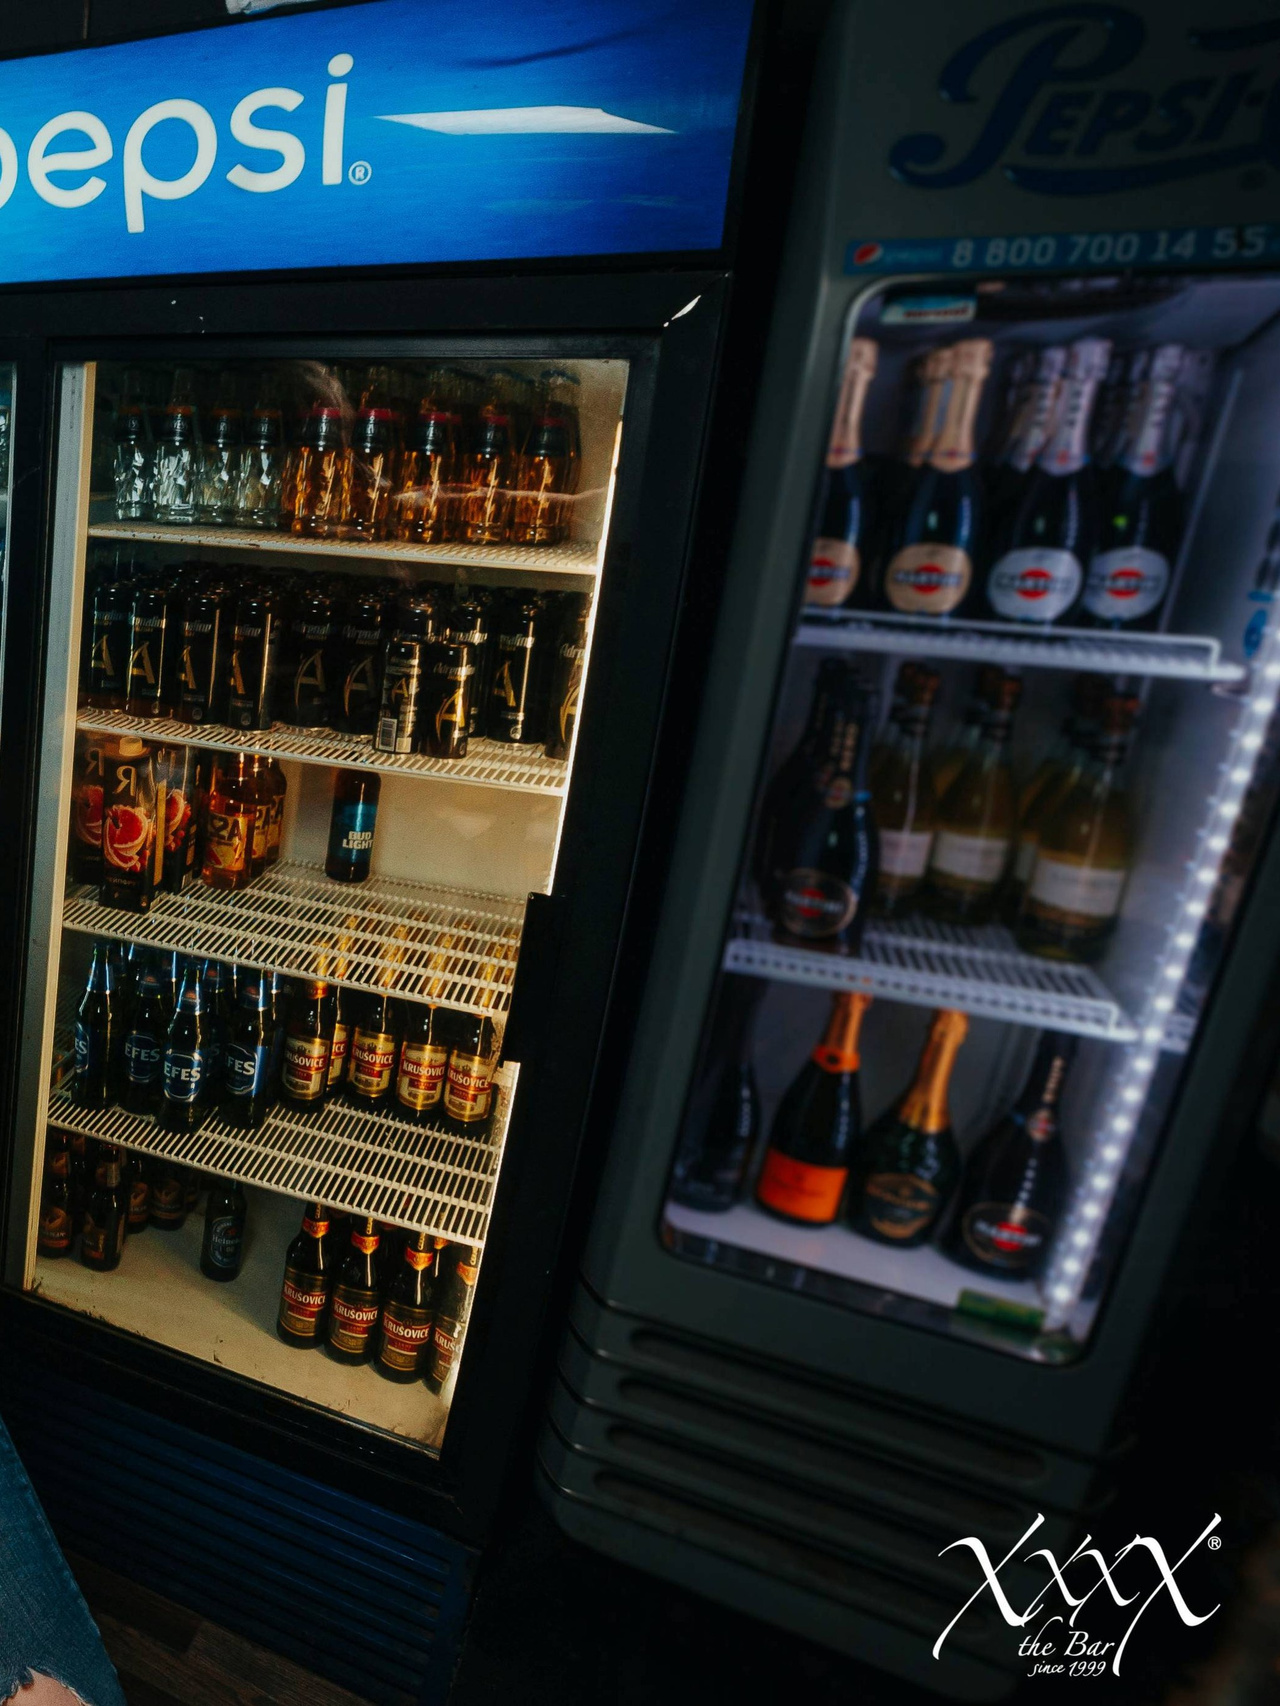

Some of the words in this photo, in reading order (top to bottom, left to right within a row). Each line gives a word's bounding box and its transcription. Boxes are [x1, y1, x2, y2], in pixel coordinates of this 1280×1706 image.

[951, 239, 974, 268] 8
[985, 235, 1057, 267] 800
[1069, 232, 1140, 264] 700
[1150, 229, 1196, 261] 14
[1213, 225, 1267, 257] 55
[342, 838, 374, 850] LIGHT
[348, 830, 372, 841] BUD
[74, 1038, 88, 1055] ES
[124, 1042, 161, 1062] EFES
[227, 1055, 255, 1076] FES
[285, 1049, 324, 1068] RUŠOVICE
[163, 1060, 201, 1082] EFES
